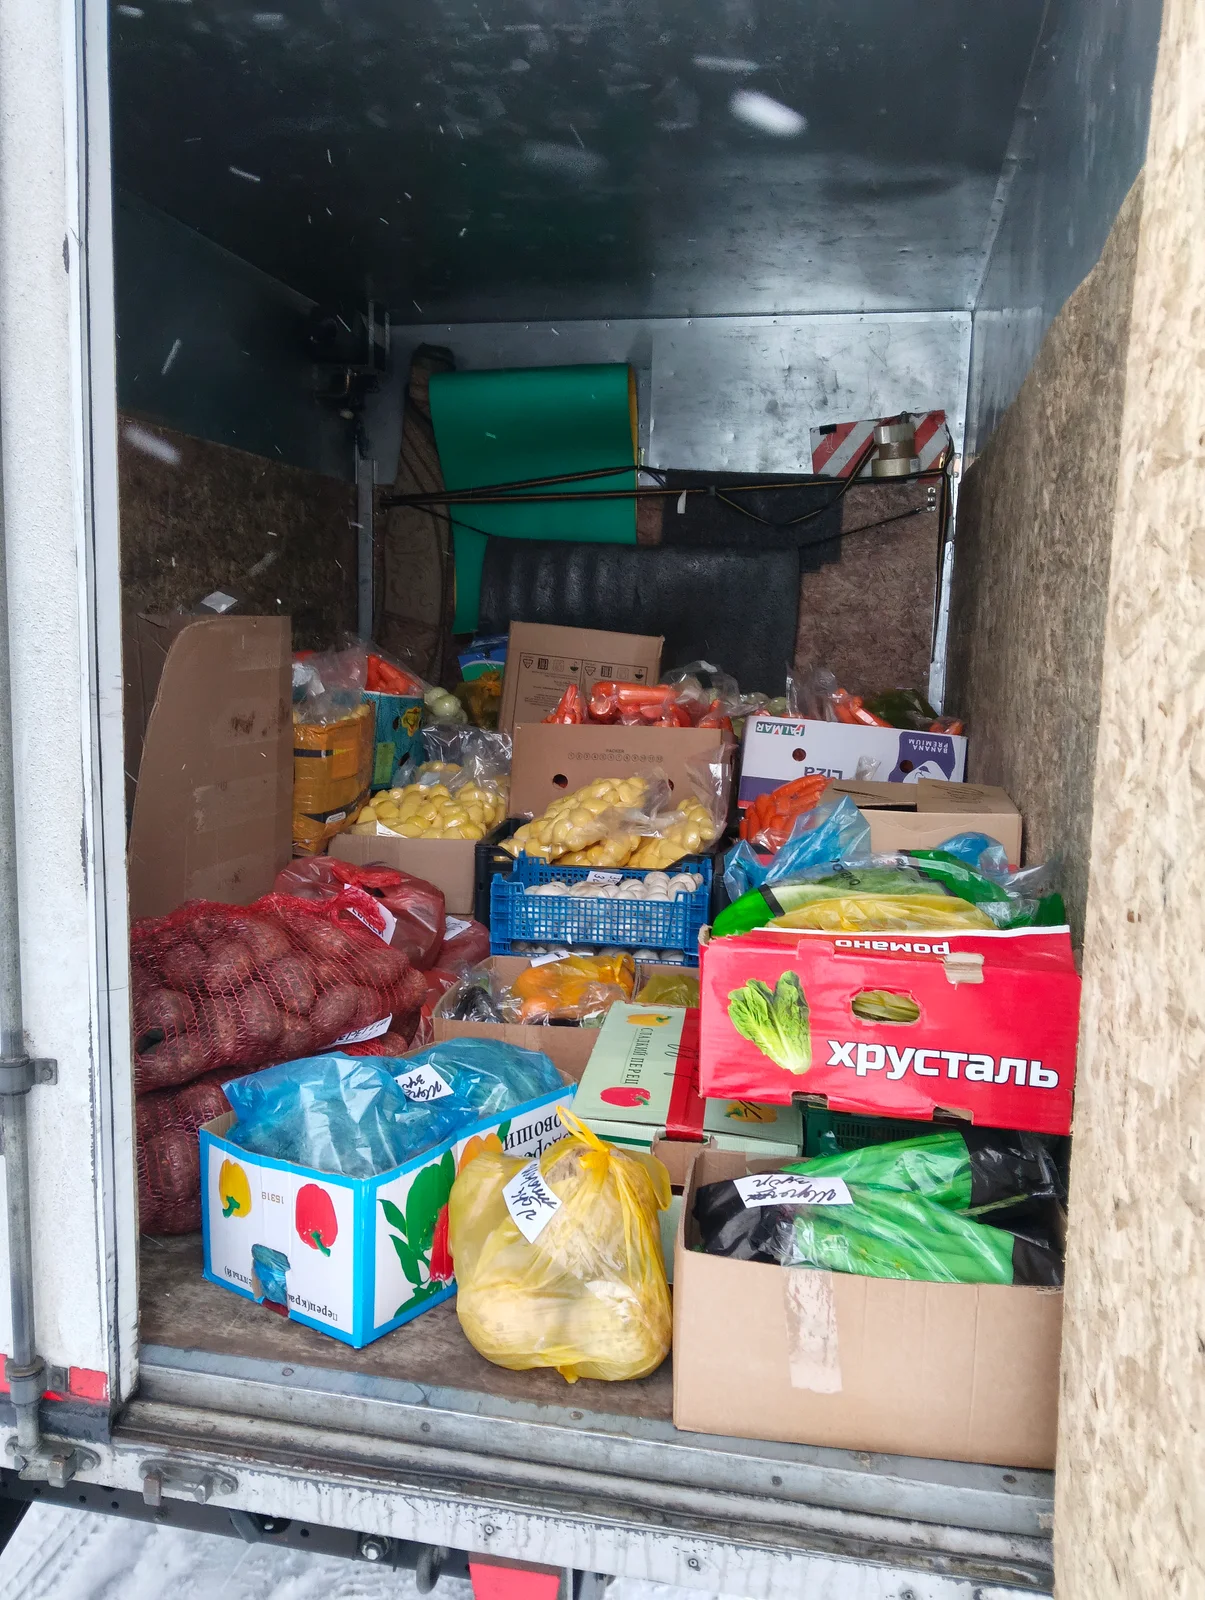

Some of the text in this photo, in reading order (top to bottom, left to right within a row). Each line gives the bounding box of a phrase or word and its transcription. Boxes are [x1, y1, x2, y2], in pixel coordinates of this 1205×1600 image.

[757, 721, 804, 736] PALMAR
[908, 738, 949, 748] PREMIUM
[912, 744, 948, 754] BANANA
[835, 939, 950, 955] романо
[624, 1057, 645, 1085] ПЕРЕЦ
[827, 1039, 1060, 1090] хрусталь
[261, 1191, 285, 1204] 15319
